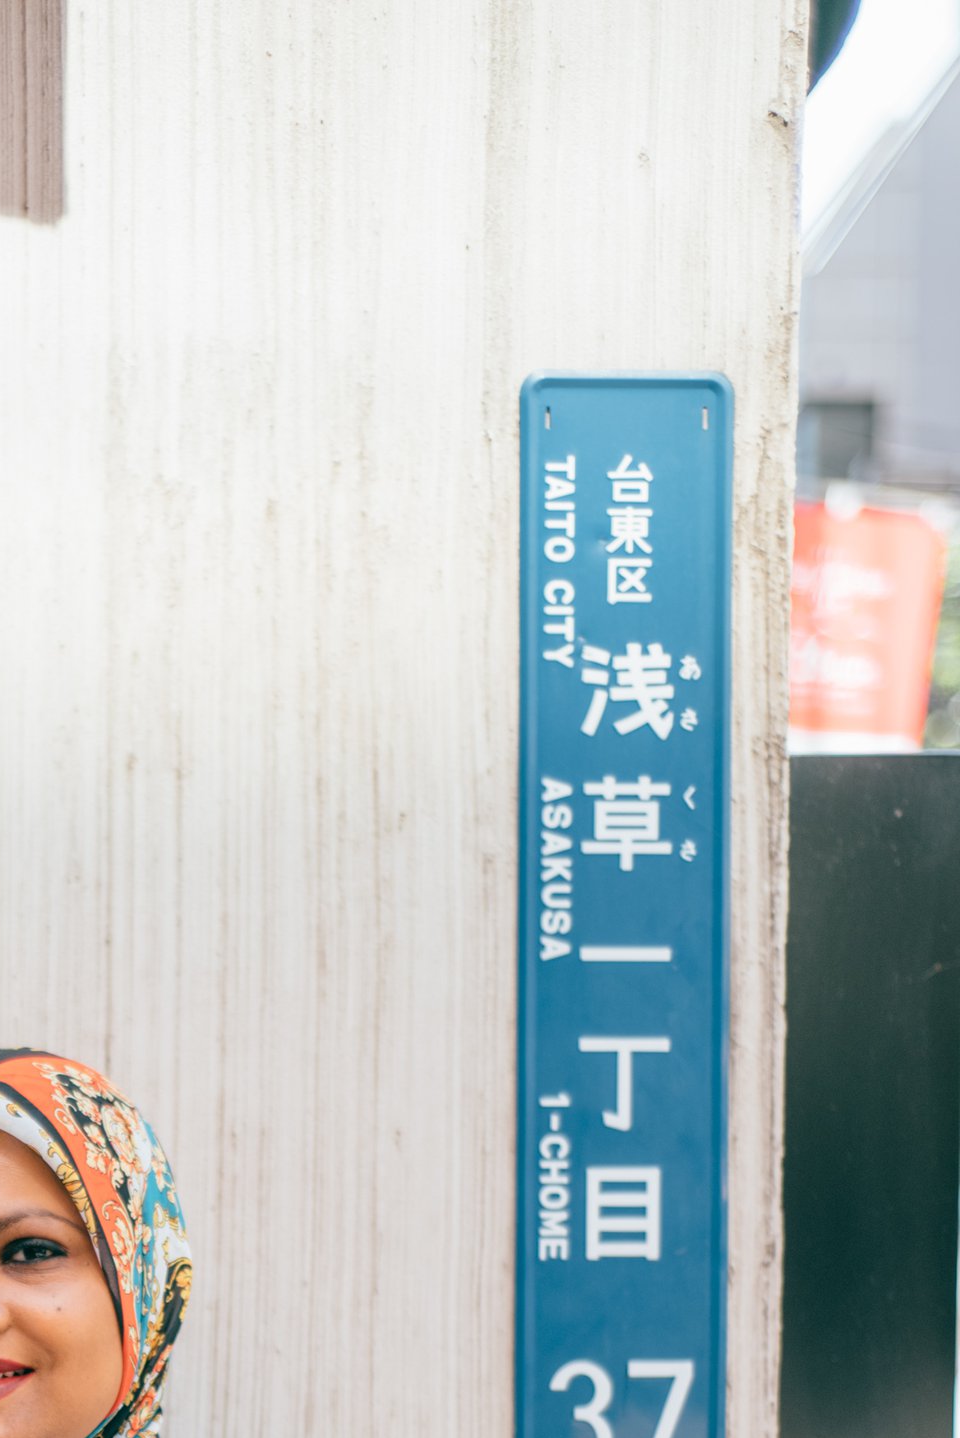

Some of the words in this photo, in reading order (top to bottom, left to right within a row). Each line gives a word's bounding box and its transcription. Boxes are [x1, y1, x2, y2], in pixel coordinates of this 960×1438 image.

[544, 454, 577, 563] TAITO
[605, 453, 654, 605] 台東区
[543, 579, 575, 668] CITY
[540, 777, 573, 963] ASAKUSA
[578, 638, 676, 1261] 浅草一丁目
[538, 1092, 571, 1261] 1-CHOME
